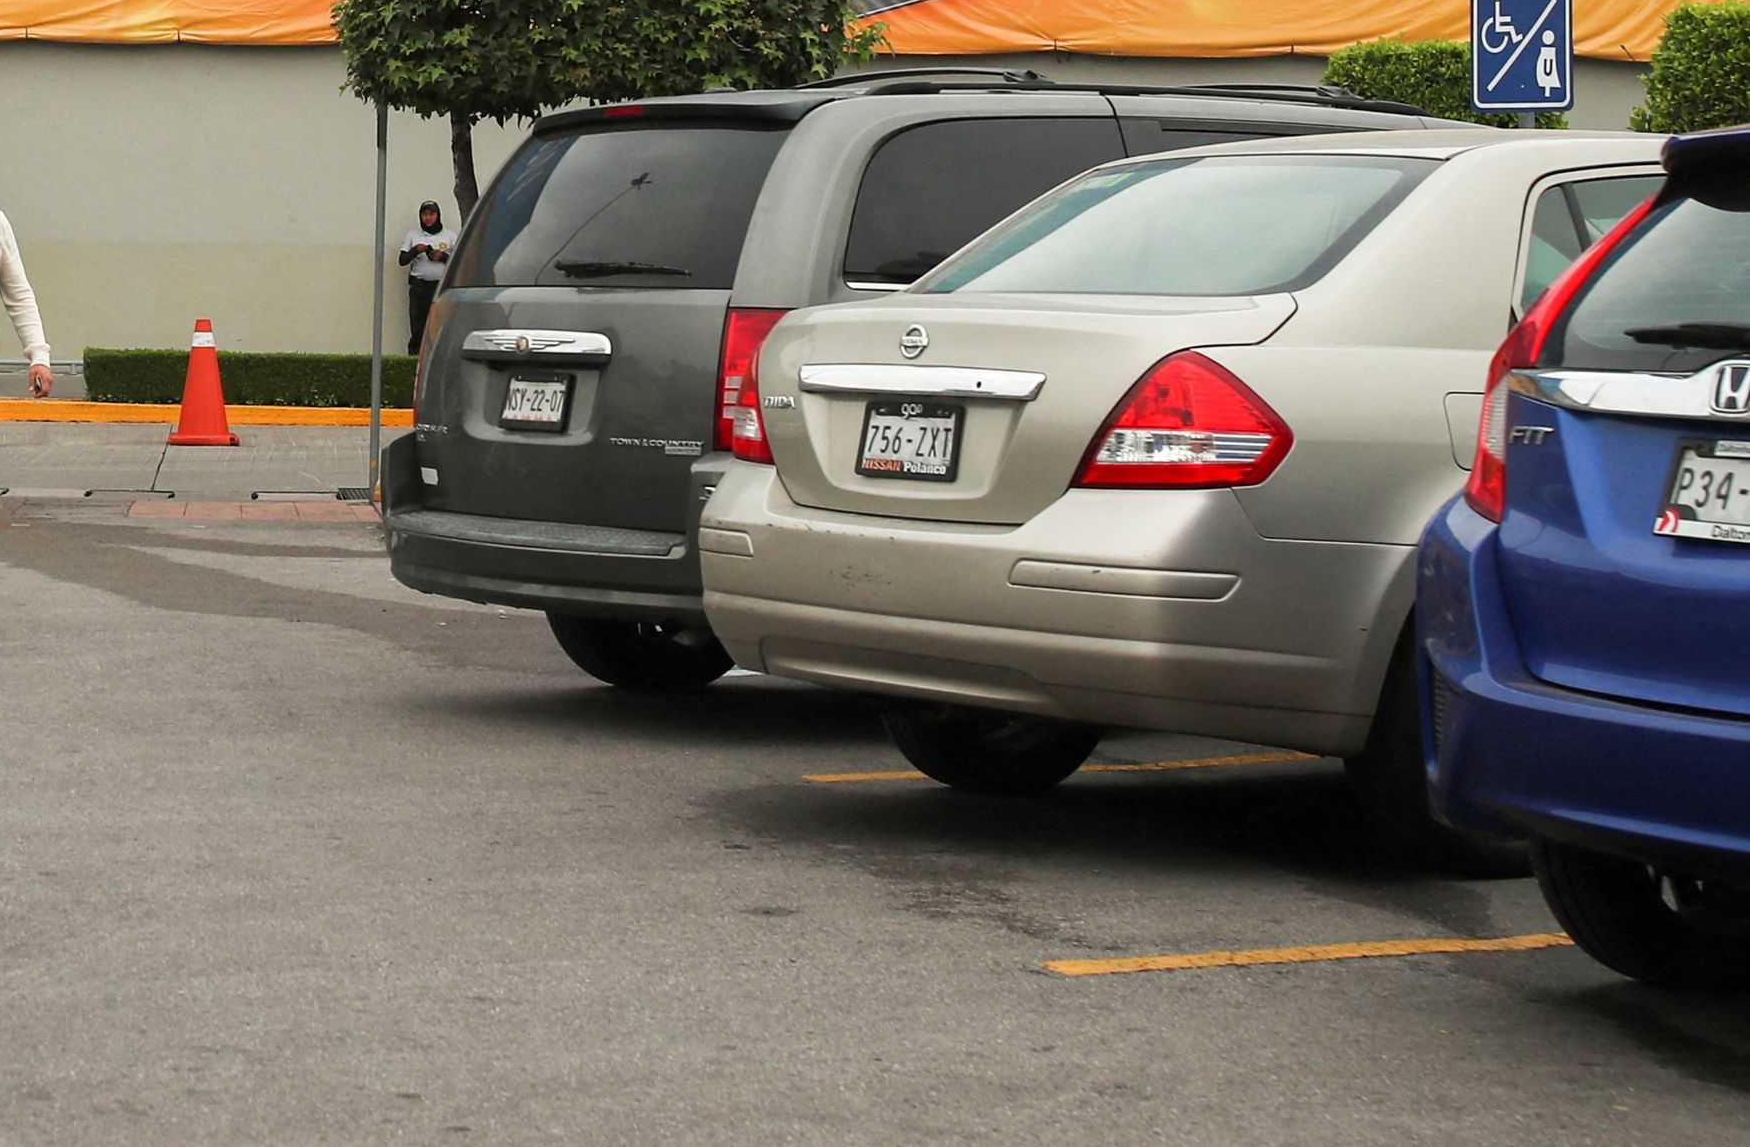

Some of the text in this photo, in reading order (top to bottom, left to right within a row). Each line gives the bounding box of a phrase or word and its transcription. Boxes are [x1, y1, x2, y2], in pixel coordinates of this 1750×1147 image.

[610, 437, 641, 446] TOWN
[649, 438, 704, 448] COUNTRY
[867, 425, 952, 458] 756-ZXT
[1508, 425, 1555, 445] FIT
[862, 458, 947, 475] NISSAN Polanco
